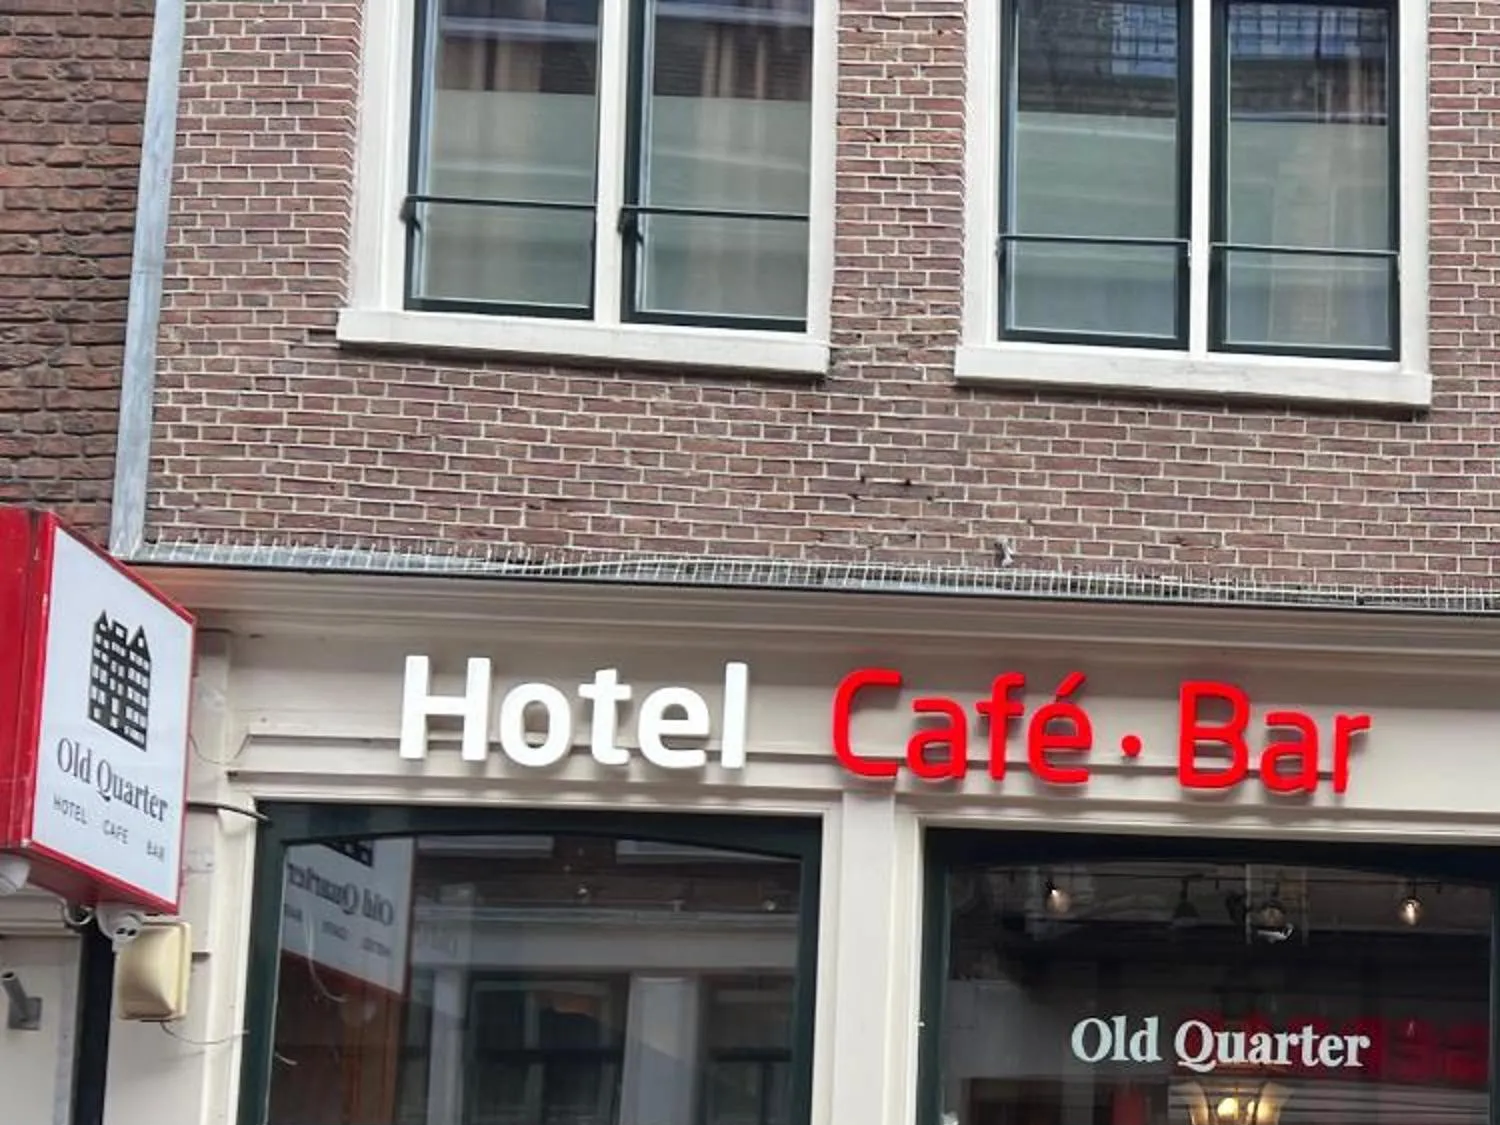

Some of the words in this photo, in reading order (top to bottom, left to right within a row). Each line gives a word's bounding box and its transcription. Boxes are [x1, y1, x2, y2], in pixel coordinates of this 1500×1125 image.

[400, 655, 749, 769] Hotel
[833, 668, 1093, 784] Café
[1178, 681, 1372, 794] Bar
[57, 738, 92, 784] Old
[96, 759, 168, 822] Quarter
[53, 791, 87, 825] HOTEL
[146, 839, 165, 862] BAR
[1071, 1015, 1163, 1063] Old
[1174, 1019, 1371, 1073] Quarter
